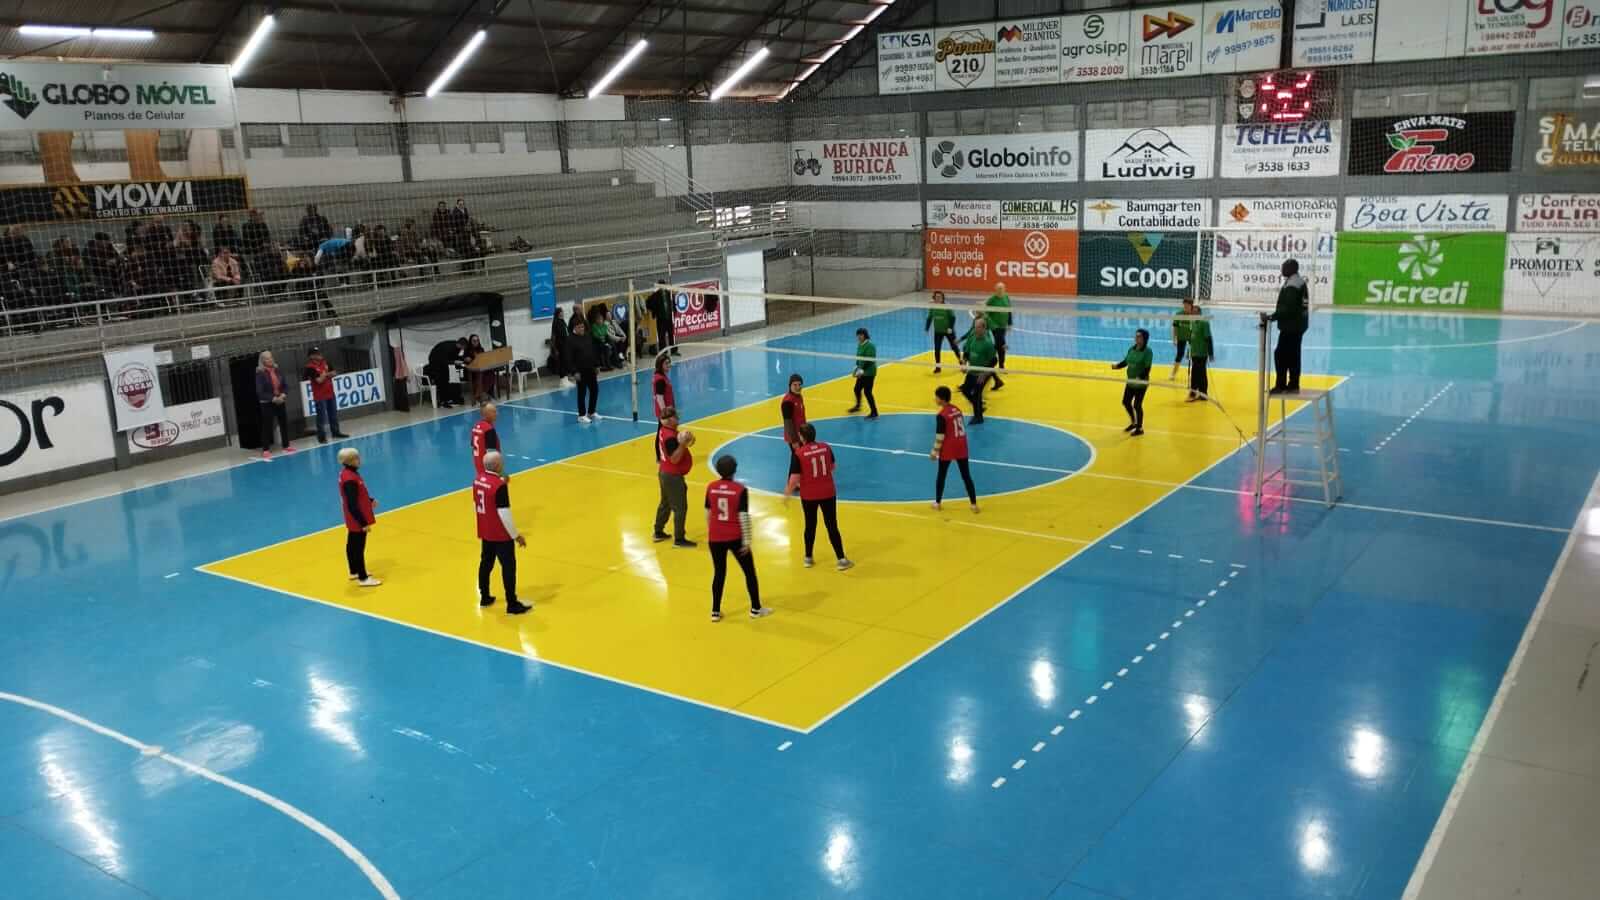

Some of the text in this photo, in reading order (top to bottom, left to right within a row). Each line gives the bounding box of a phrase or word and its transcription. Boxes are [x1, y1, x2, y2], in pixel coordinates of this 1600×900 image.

[1235, 5, 1281, 23] Marcelo
[1341, 13, 1374, 27] LAJES
[901, 32, 932, 48] KSA
[1023, 31, 1061, 42] GRANITOS
[1062, 40, 1128, 59] agrosipp
[951, 58, 980, 74] 210
[42, 81, 216, 105] GLOBO MÓVEL
[84, 110, 185, 121] Planos de Celular
[1394, 115, 1466, 132] ERVA-MATE
[1236, 121, 1332, 145] TCHEKA
[968, 146, 1072, 168] Globoinfo
[1292, 144, 1330, 157] pneus
[1102, 161, 1196, 179] Ludwig
[1257, 161, 1284, 172] 3538
[94, 180, 194, 210] MOWI
[96, 205, 198, 217] CENTRO DE TREINAMENTO
[1002, 199, 1077, 215] COMERCIAL HS
[1126, 201, 1201, 214] Baumgarten
[1253, 199, 1337, 210] MARMORARIA
[1119, 215, 1200, 228] Contabilidade
[1351, 200, 1490, 229] Boa Vista
[939, 232, 970, 245] centro
[973, 232, 985, 245] de
[931, 248, 984, 263] cada jogada
[932, 263, 940, 277] é
[995, 261, 1076, 279] CRESOL
[1510, 258, 1584, 273] PROMOTEX
[1100, 266, 1189, 289] SICOOB
[1365, 280, 1470, 305] Sicredi
[356, 371, 375, 388] DO
[811, 455, 827, 478] 11
[476, 489, 486, 514] 3
[717, 497, 729, 521] 9
